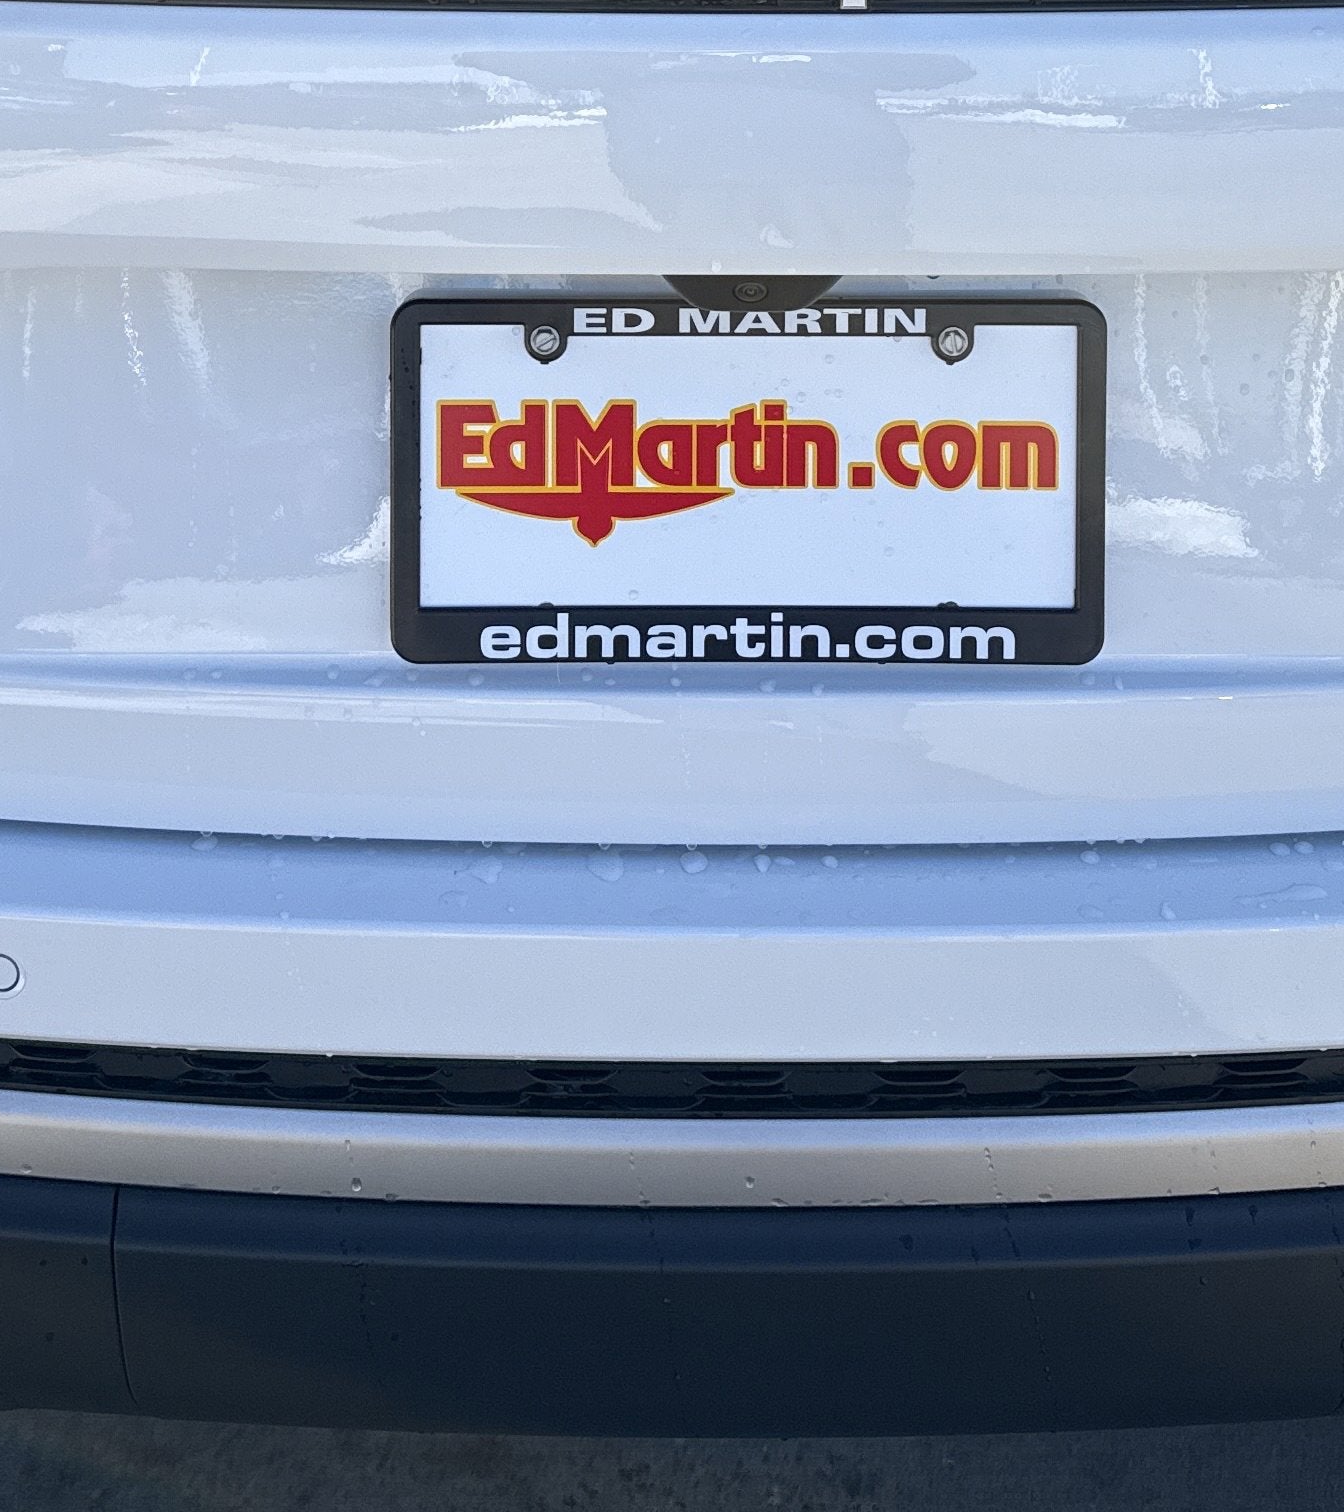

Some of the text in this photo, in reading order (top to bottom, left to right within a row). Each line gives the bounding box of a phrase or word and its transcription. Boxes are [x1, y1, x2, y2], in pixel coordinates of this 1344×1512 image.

[573, 307, 928, 334] ED MARTIN
[436, 397, 1060, 494] EdMartin.com
[479, 611, 1017, 660] edmartin.com
